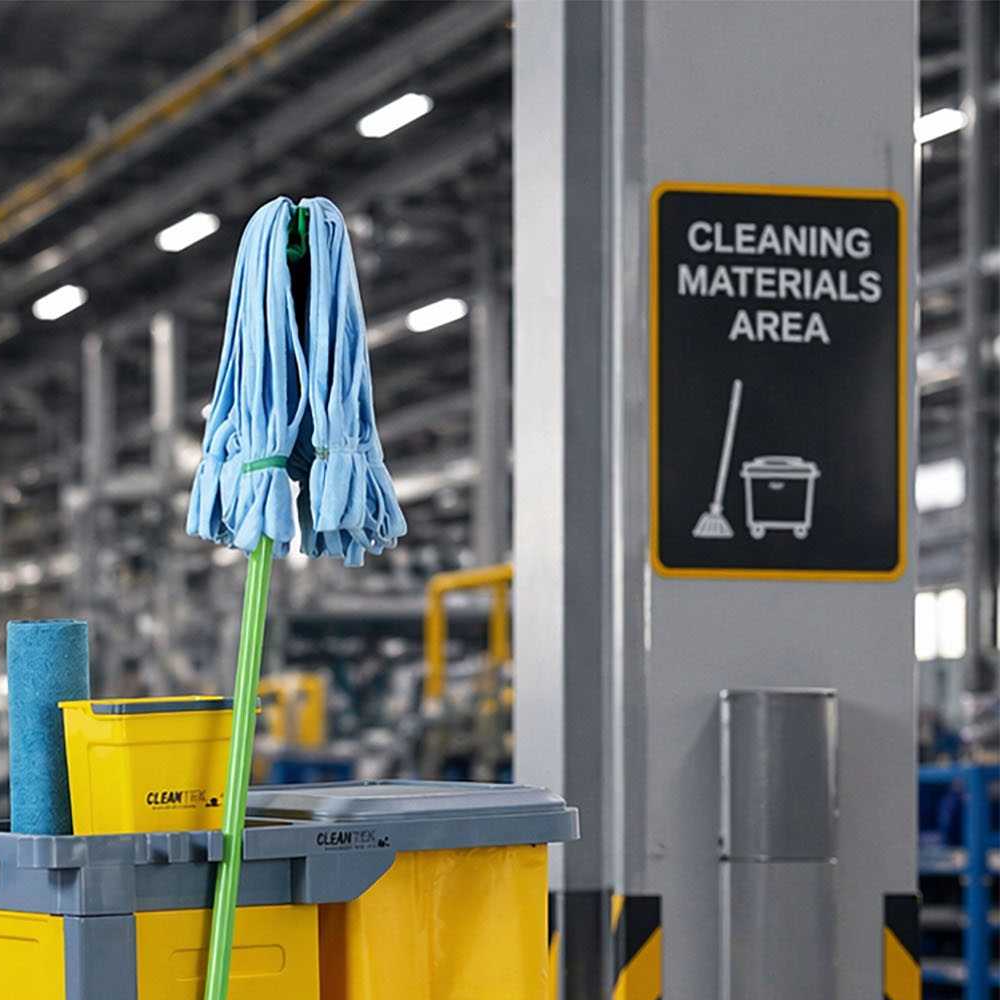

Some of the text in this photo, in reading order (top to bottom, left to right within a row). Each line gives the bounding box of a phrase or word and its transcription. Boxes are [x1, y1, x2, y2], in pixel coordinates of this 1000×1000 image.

[687, 221, 871, 258] CLEANING
[678, 264, 882, 302] MATERIALS
[728, 309, 830, 344] AREA
